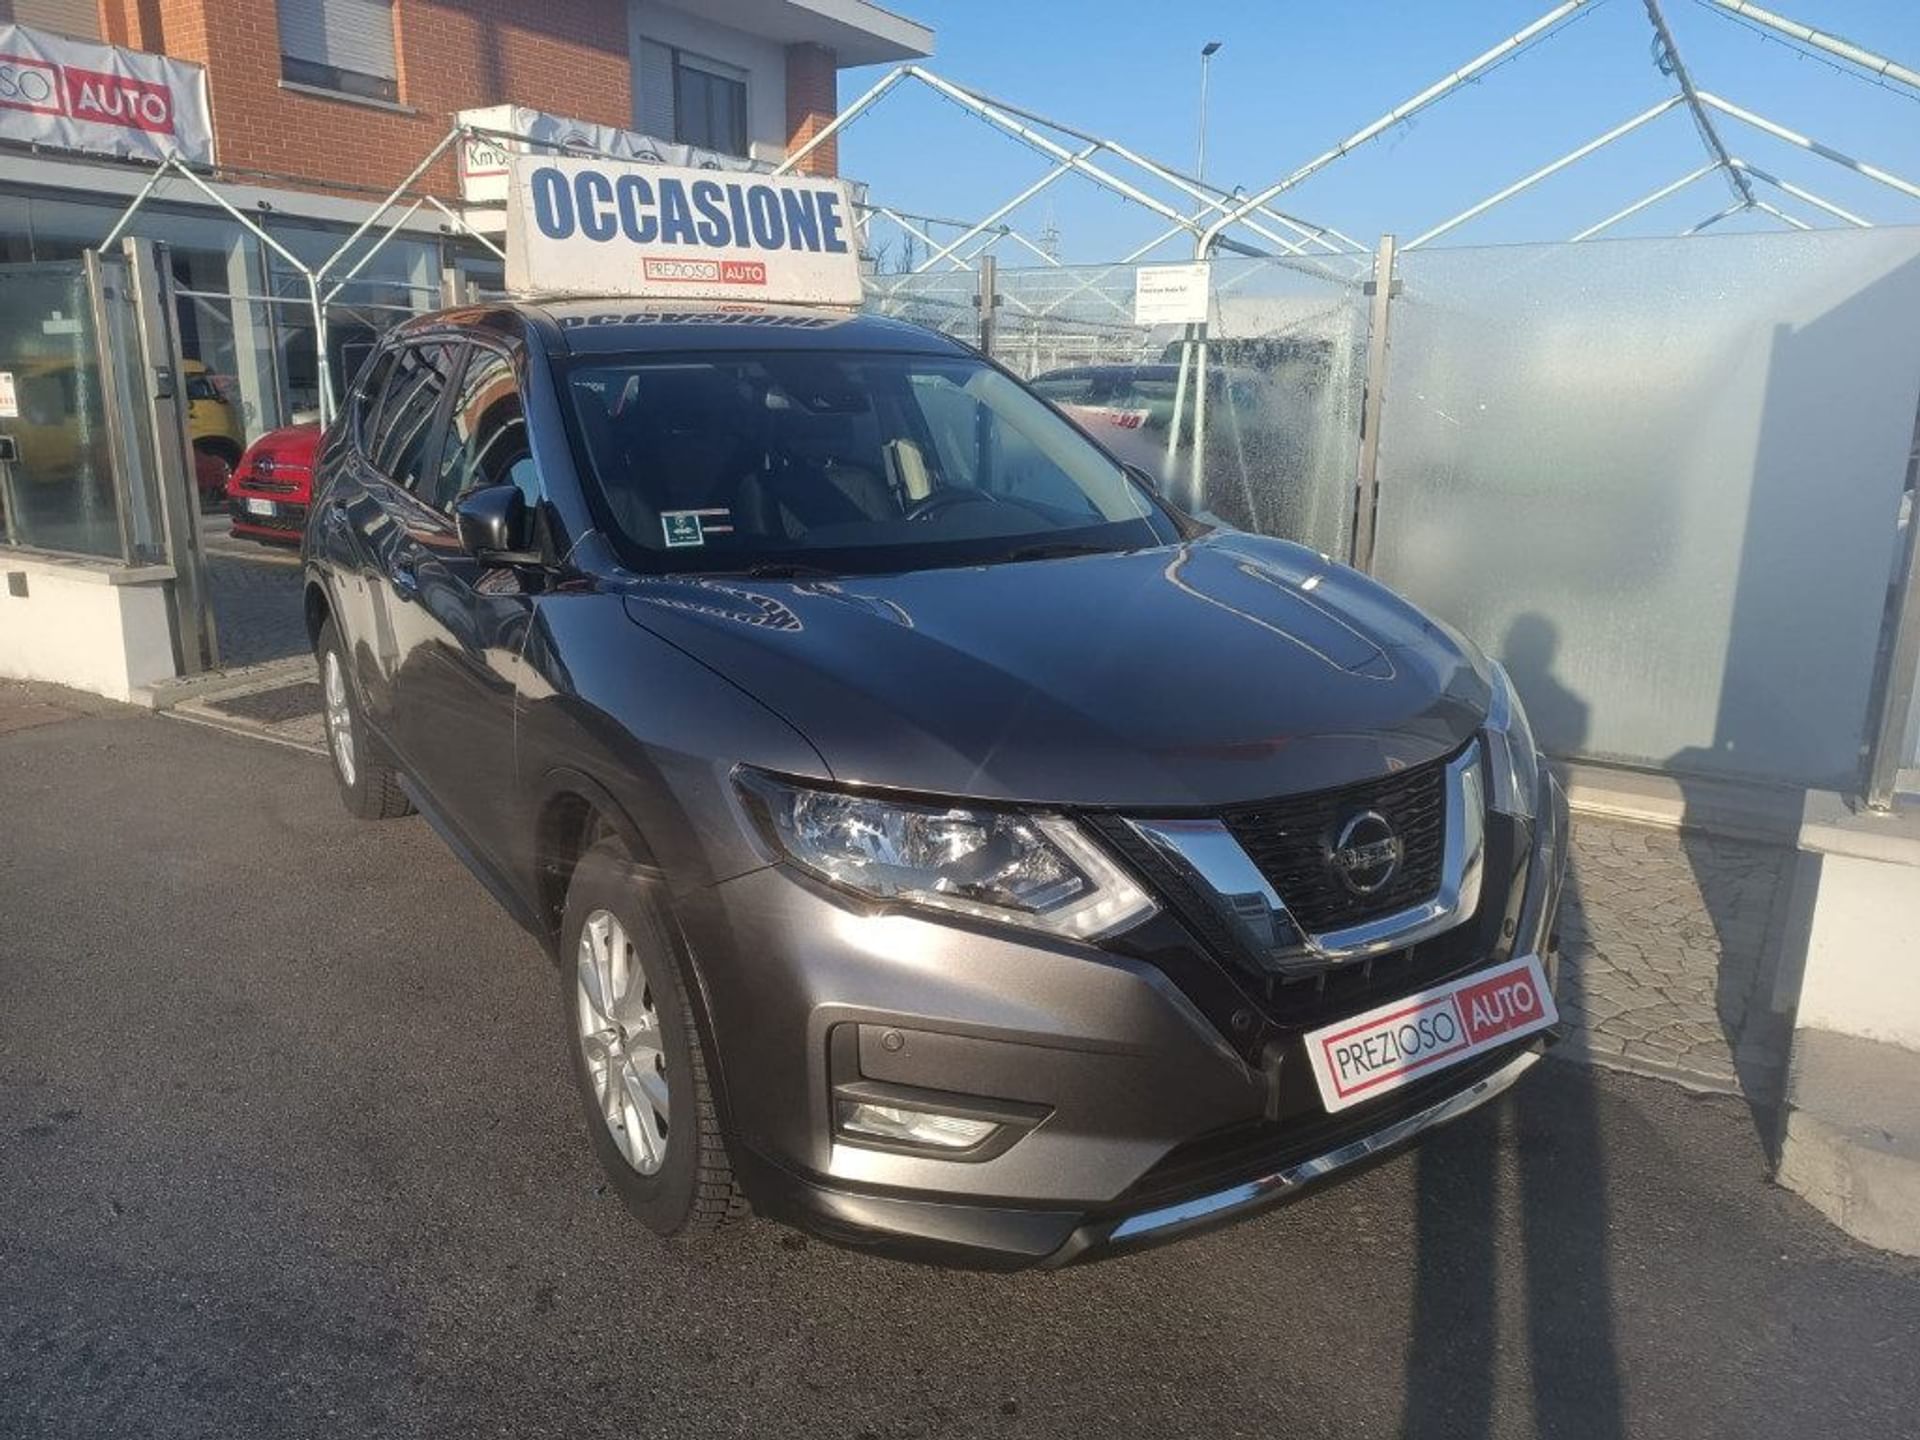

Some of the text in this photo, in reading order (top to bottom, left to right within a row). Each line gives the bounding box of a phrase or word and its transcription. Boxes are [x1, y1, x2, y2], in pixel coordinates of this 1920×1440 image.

[79, 80, 167, 124] AUTO
[530, 166, 848, 254] OCCASIONE
[648, 262, 763, 280] PREZIOSO AUTO
[1336, 981, 1535, 1080] PREZIOSO AUTO
